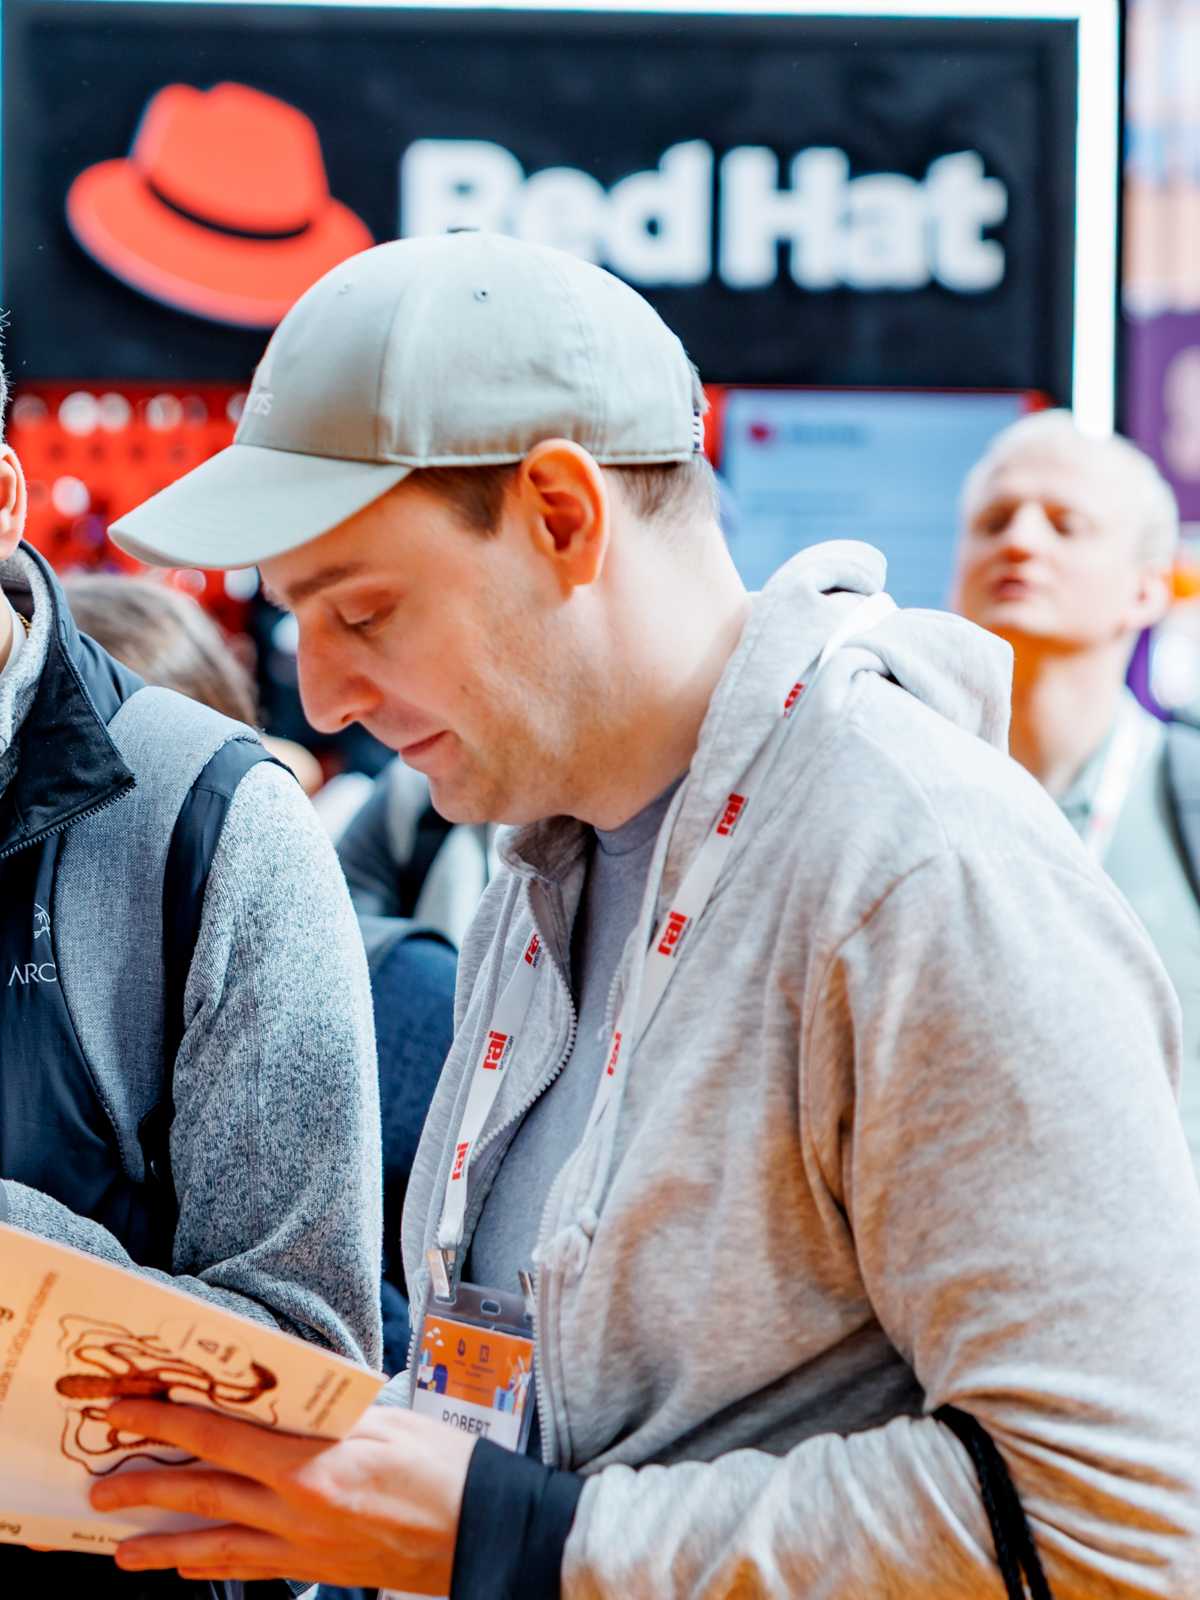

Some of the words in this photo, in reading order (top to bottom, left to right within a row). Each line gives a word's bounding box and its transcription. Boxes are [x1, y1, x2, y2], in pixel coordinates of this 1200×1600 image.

[400, 138, 714, 286] Red
[718, 145, 1008, 292] Hat
[716, 792, 745, 836] rai
[525, 934, 540, 965] ra
[657, 911, 687, 956] rai
[483, 1030, 508, 1070] rai
[452, 1142, 469, 1181] rai
